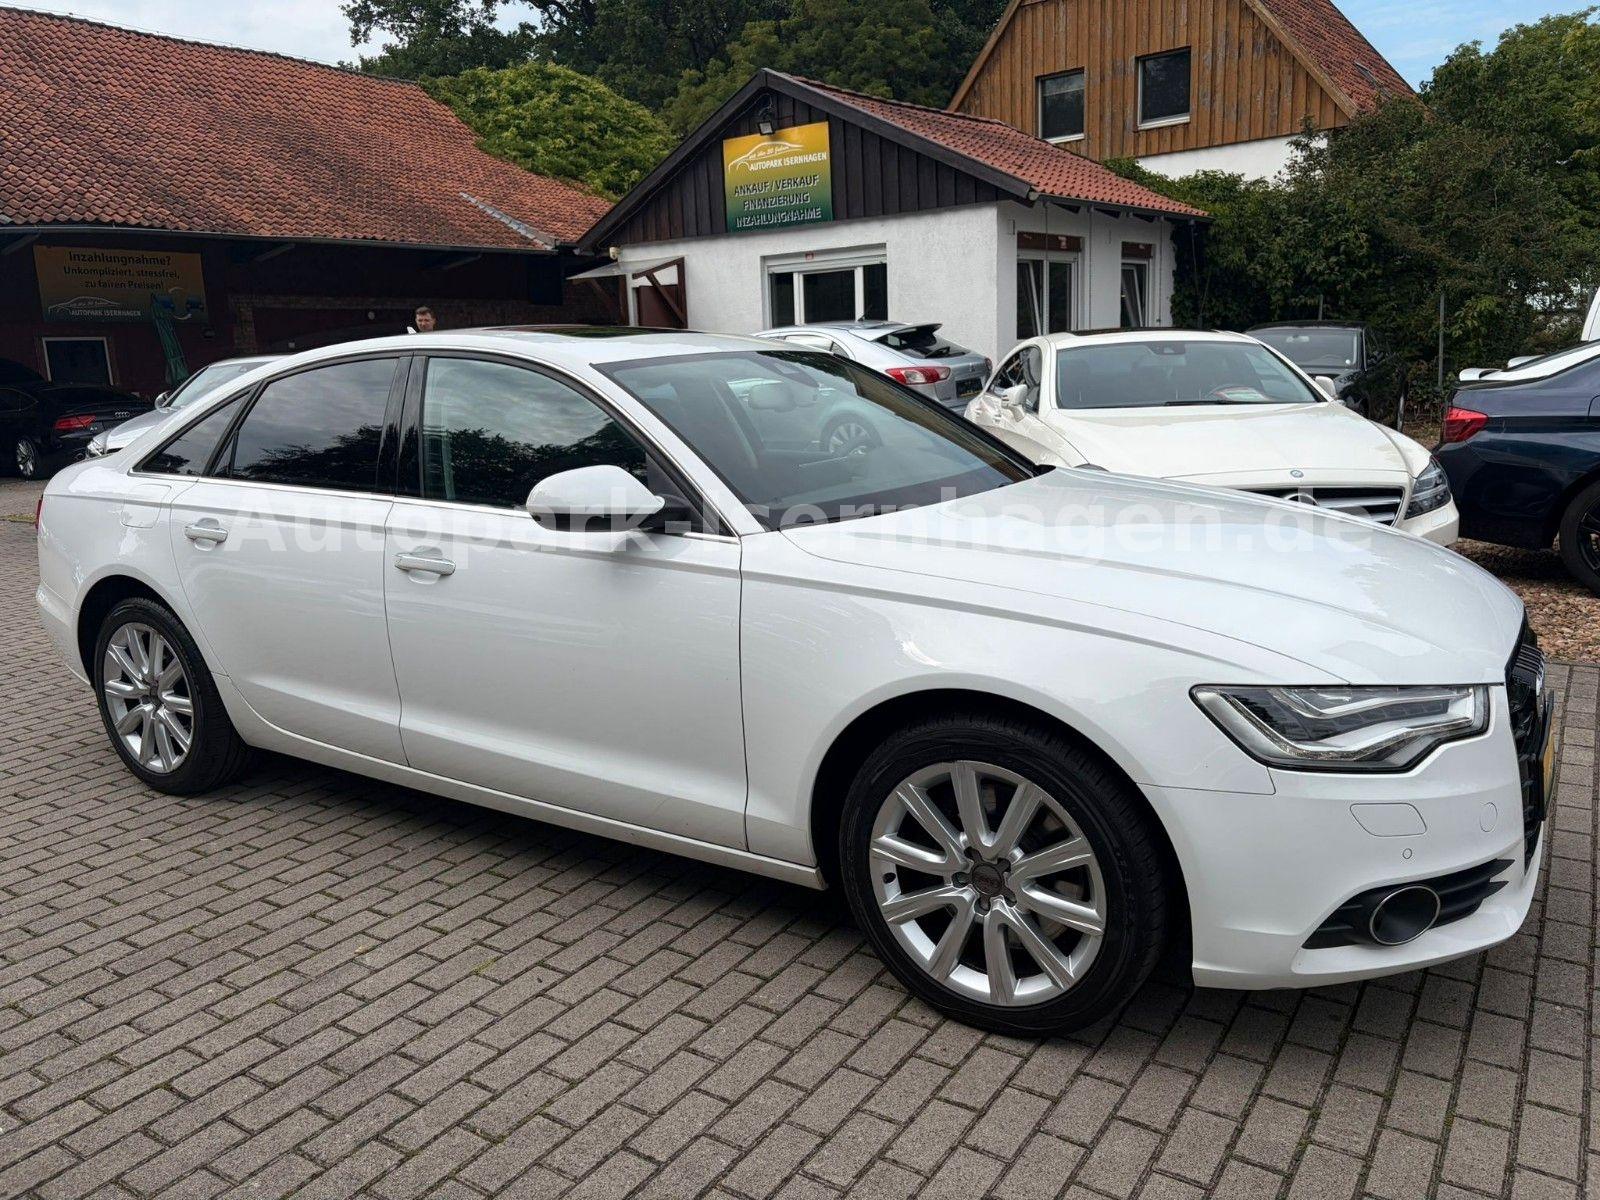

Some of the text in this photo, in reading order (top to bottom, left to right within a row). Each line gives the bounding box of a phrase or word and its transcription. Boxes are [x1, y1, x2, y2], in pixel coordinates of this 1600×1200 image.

[750, 158, 782, 171] AUTOPARK
[783, 152, 827, 166] ISERNHAGEN
[735, 181, 770, 197] ANKAUF
[777, 174, 820, 191] VERKAUF
[744, 193, 811, 211] FINANZIERUNG
[69, 251, 171, 266] Inzahlungnahme?
